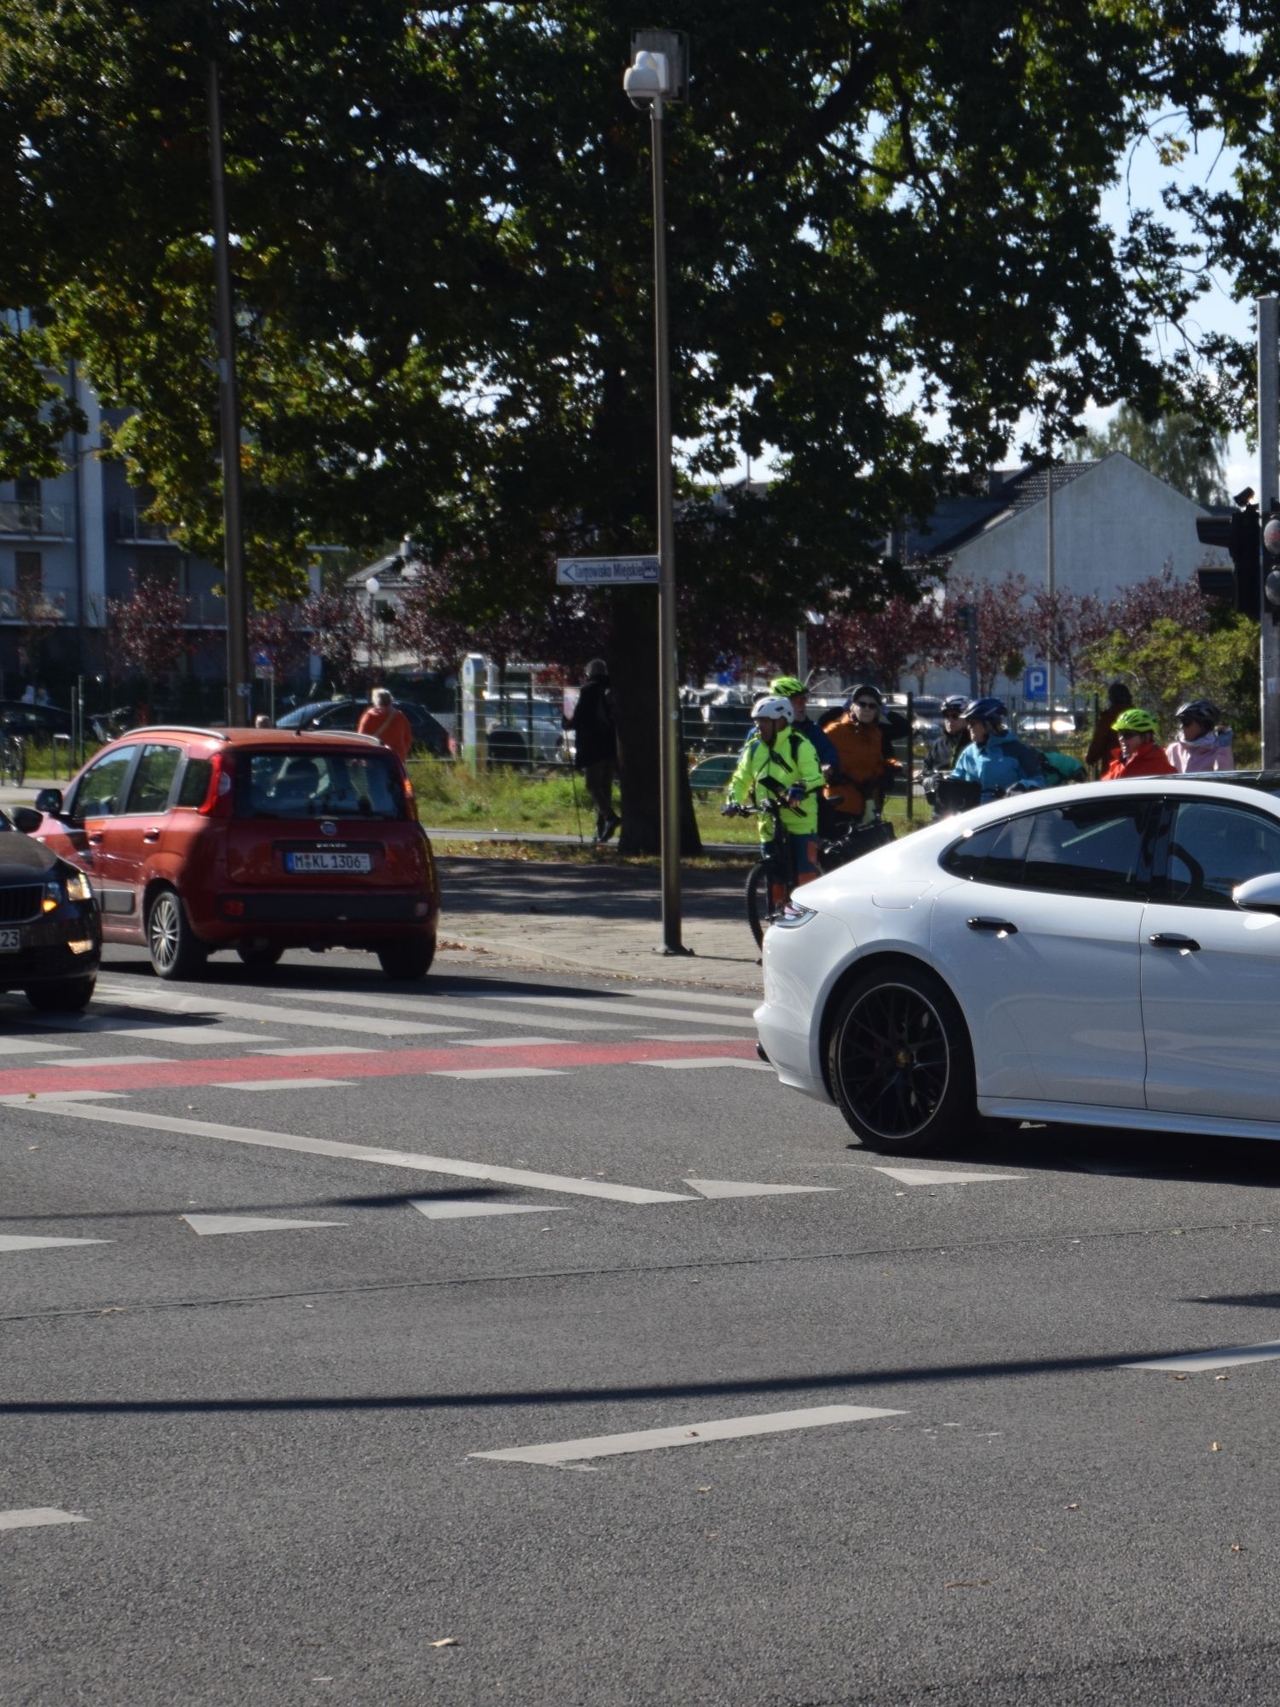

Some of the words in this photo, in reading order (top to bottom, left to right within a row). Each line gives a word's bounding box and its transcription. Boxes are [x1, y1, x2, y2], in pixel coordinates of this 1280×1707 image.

[1030, 671, 1044, 692] P
[312, 855, 328, 868] KL
[332, 855, 361, 868] 1306
